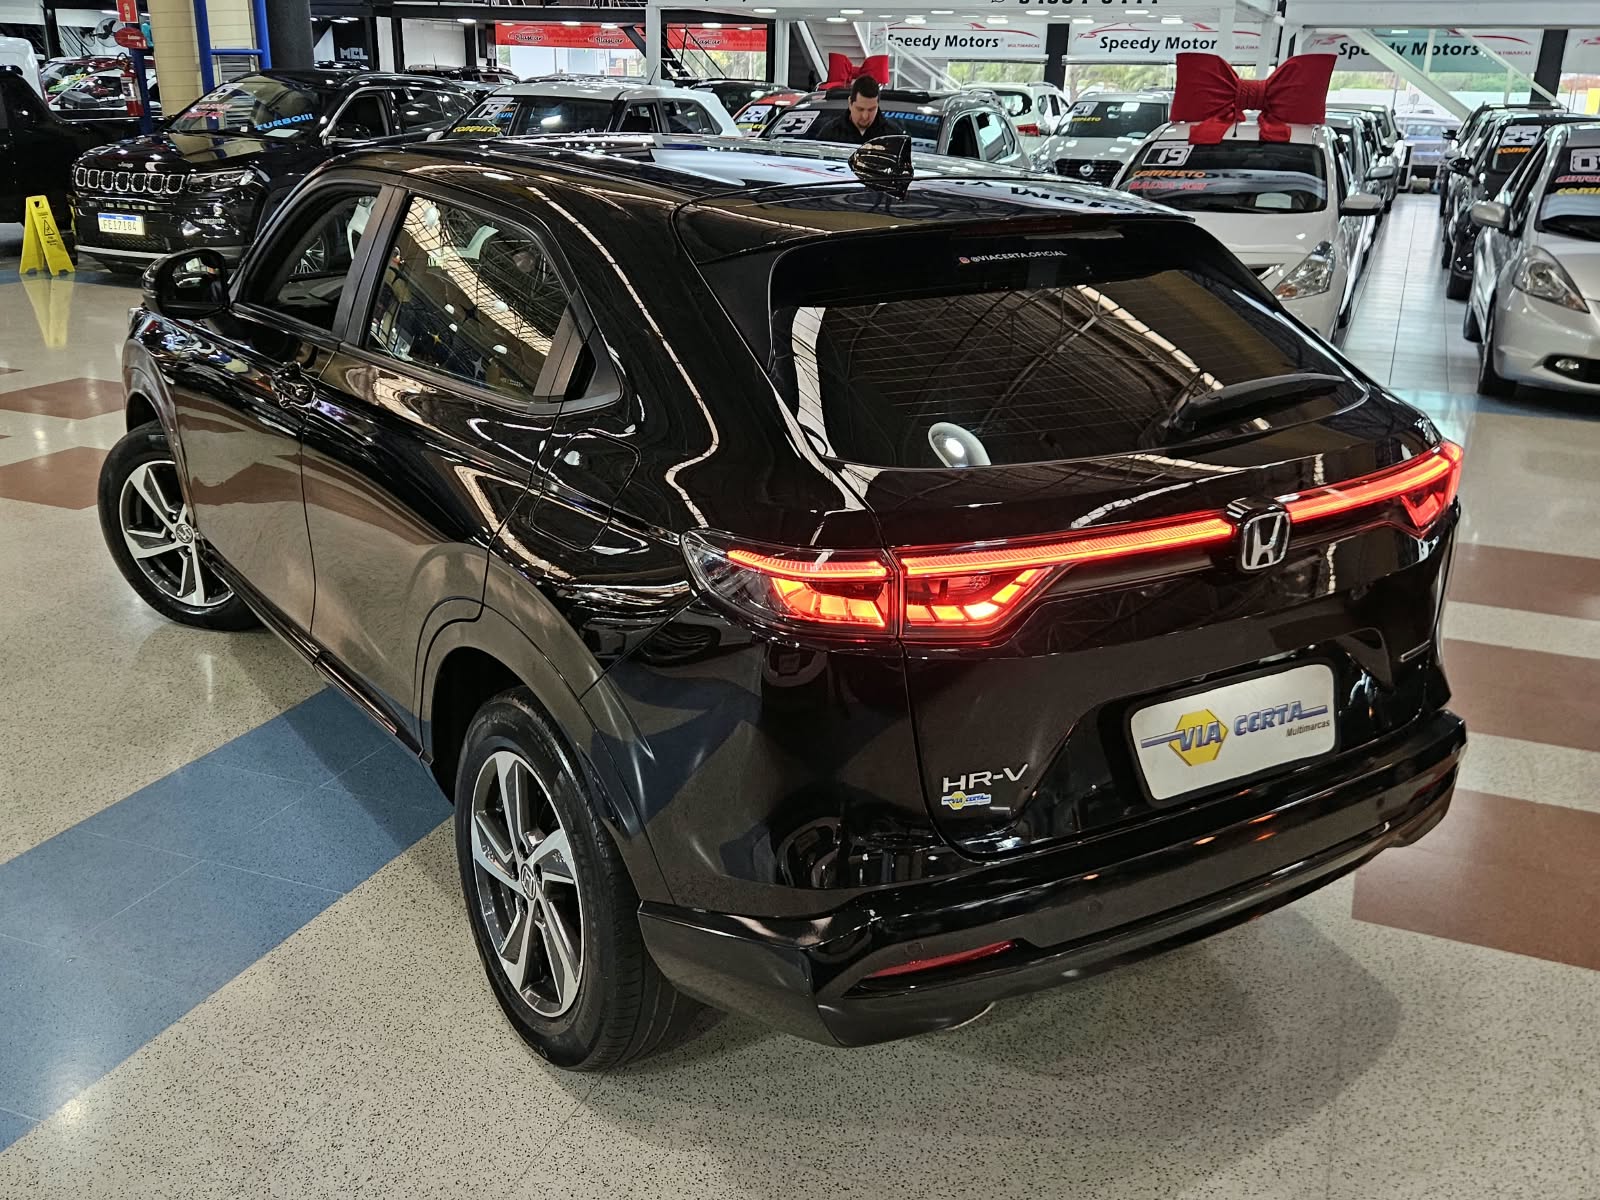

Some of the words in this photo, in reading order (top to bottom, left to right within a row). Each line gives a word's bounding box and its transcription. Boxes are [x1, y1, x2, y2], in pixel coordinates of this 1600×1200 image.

[945, 35, 999, 48] Motors
[1099, 36, 1160, 53] Speedy
[1165, 37, 1218, 50] Motor
[1411, 41, 1480, 56] Motors
[452, 125, 501, 133] COMPLETO
[775, 117, 812, 134] 23
[1503, 131, 1537, 145] 25
[1157, 147, 1186, 164] 19
[1573, 155, 1600, 171] 0
[1133, 169, 1206, 178] COMPLETO
[1178, 720, 1222, 751] VIA
[1286, 719, 1331, 737] Multimarcas
[942, 763, 1029, 793] HR-V
